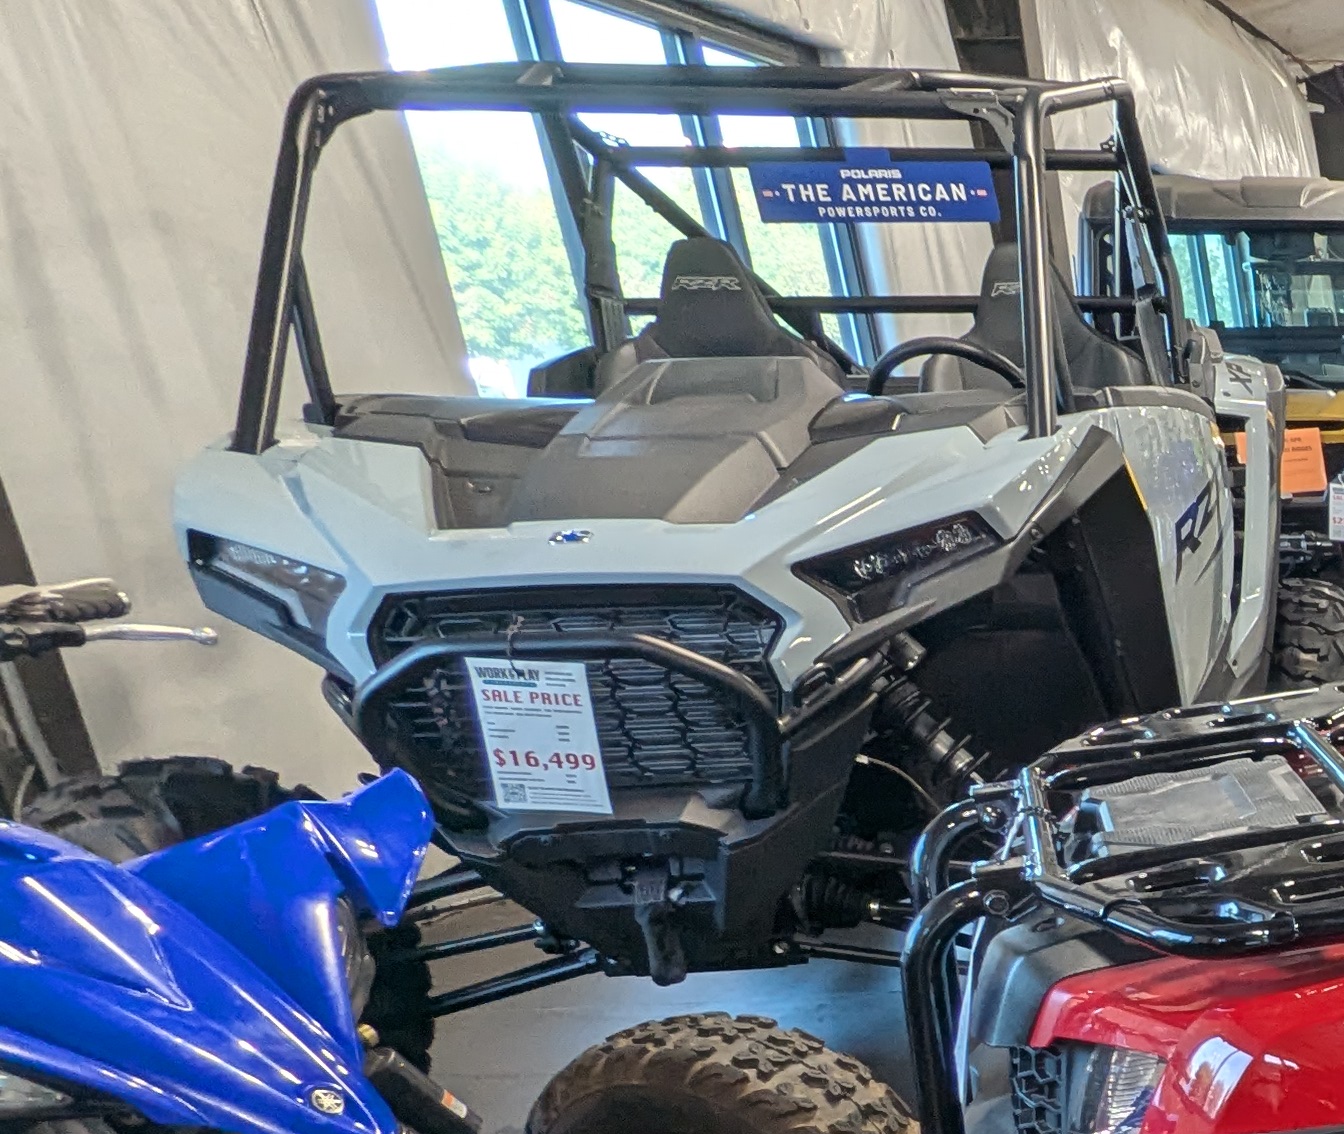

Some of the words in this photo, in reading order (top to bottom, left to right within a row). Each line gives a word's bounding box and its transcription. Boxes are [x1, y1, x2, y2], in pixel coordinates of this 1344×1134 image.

[839, 168, 902, 179] POLARIS
[781, 183, 832, 202] THE
[841, 183, 968, 202] AMERICAN
[817, 206, 915, 218] POWERSPORTS
[919, 206, 943, 217] CO.
[671, 276, 742, 291] RZR
[481, 689, 524, 704] SALE
[529, 691, 583, 706] PRICE
[493, 748, 596, 771] $16,499
